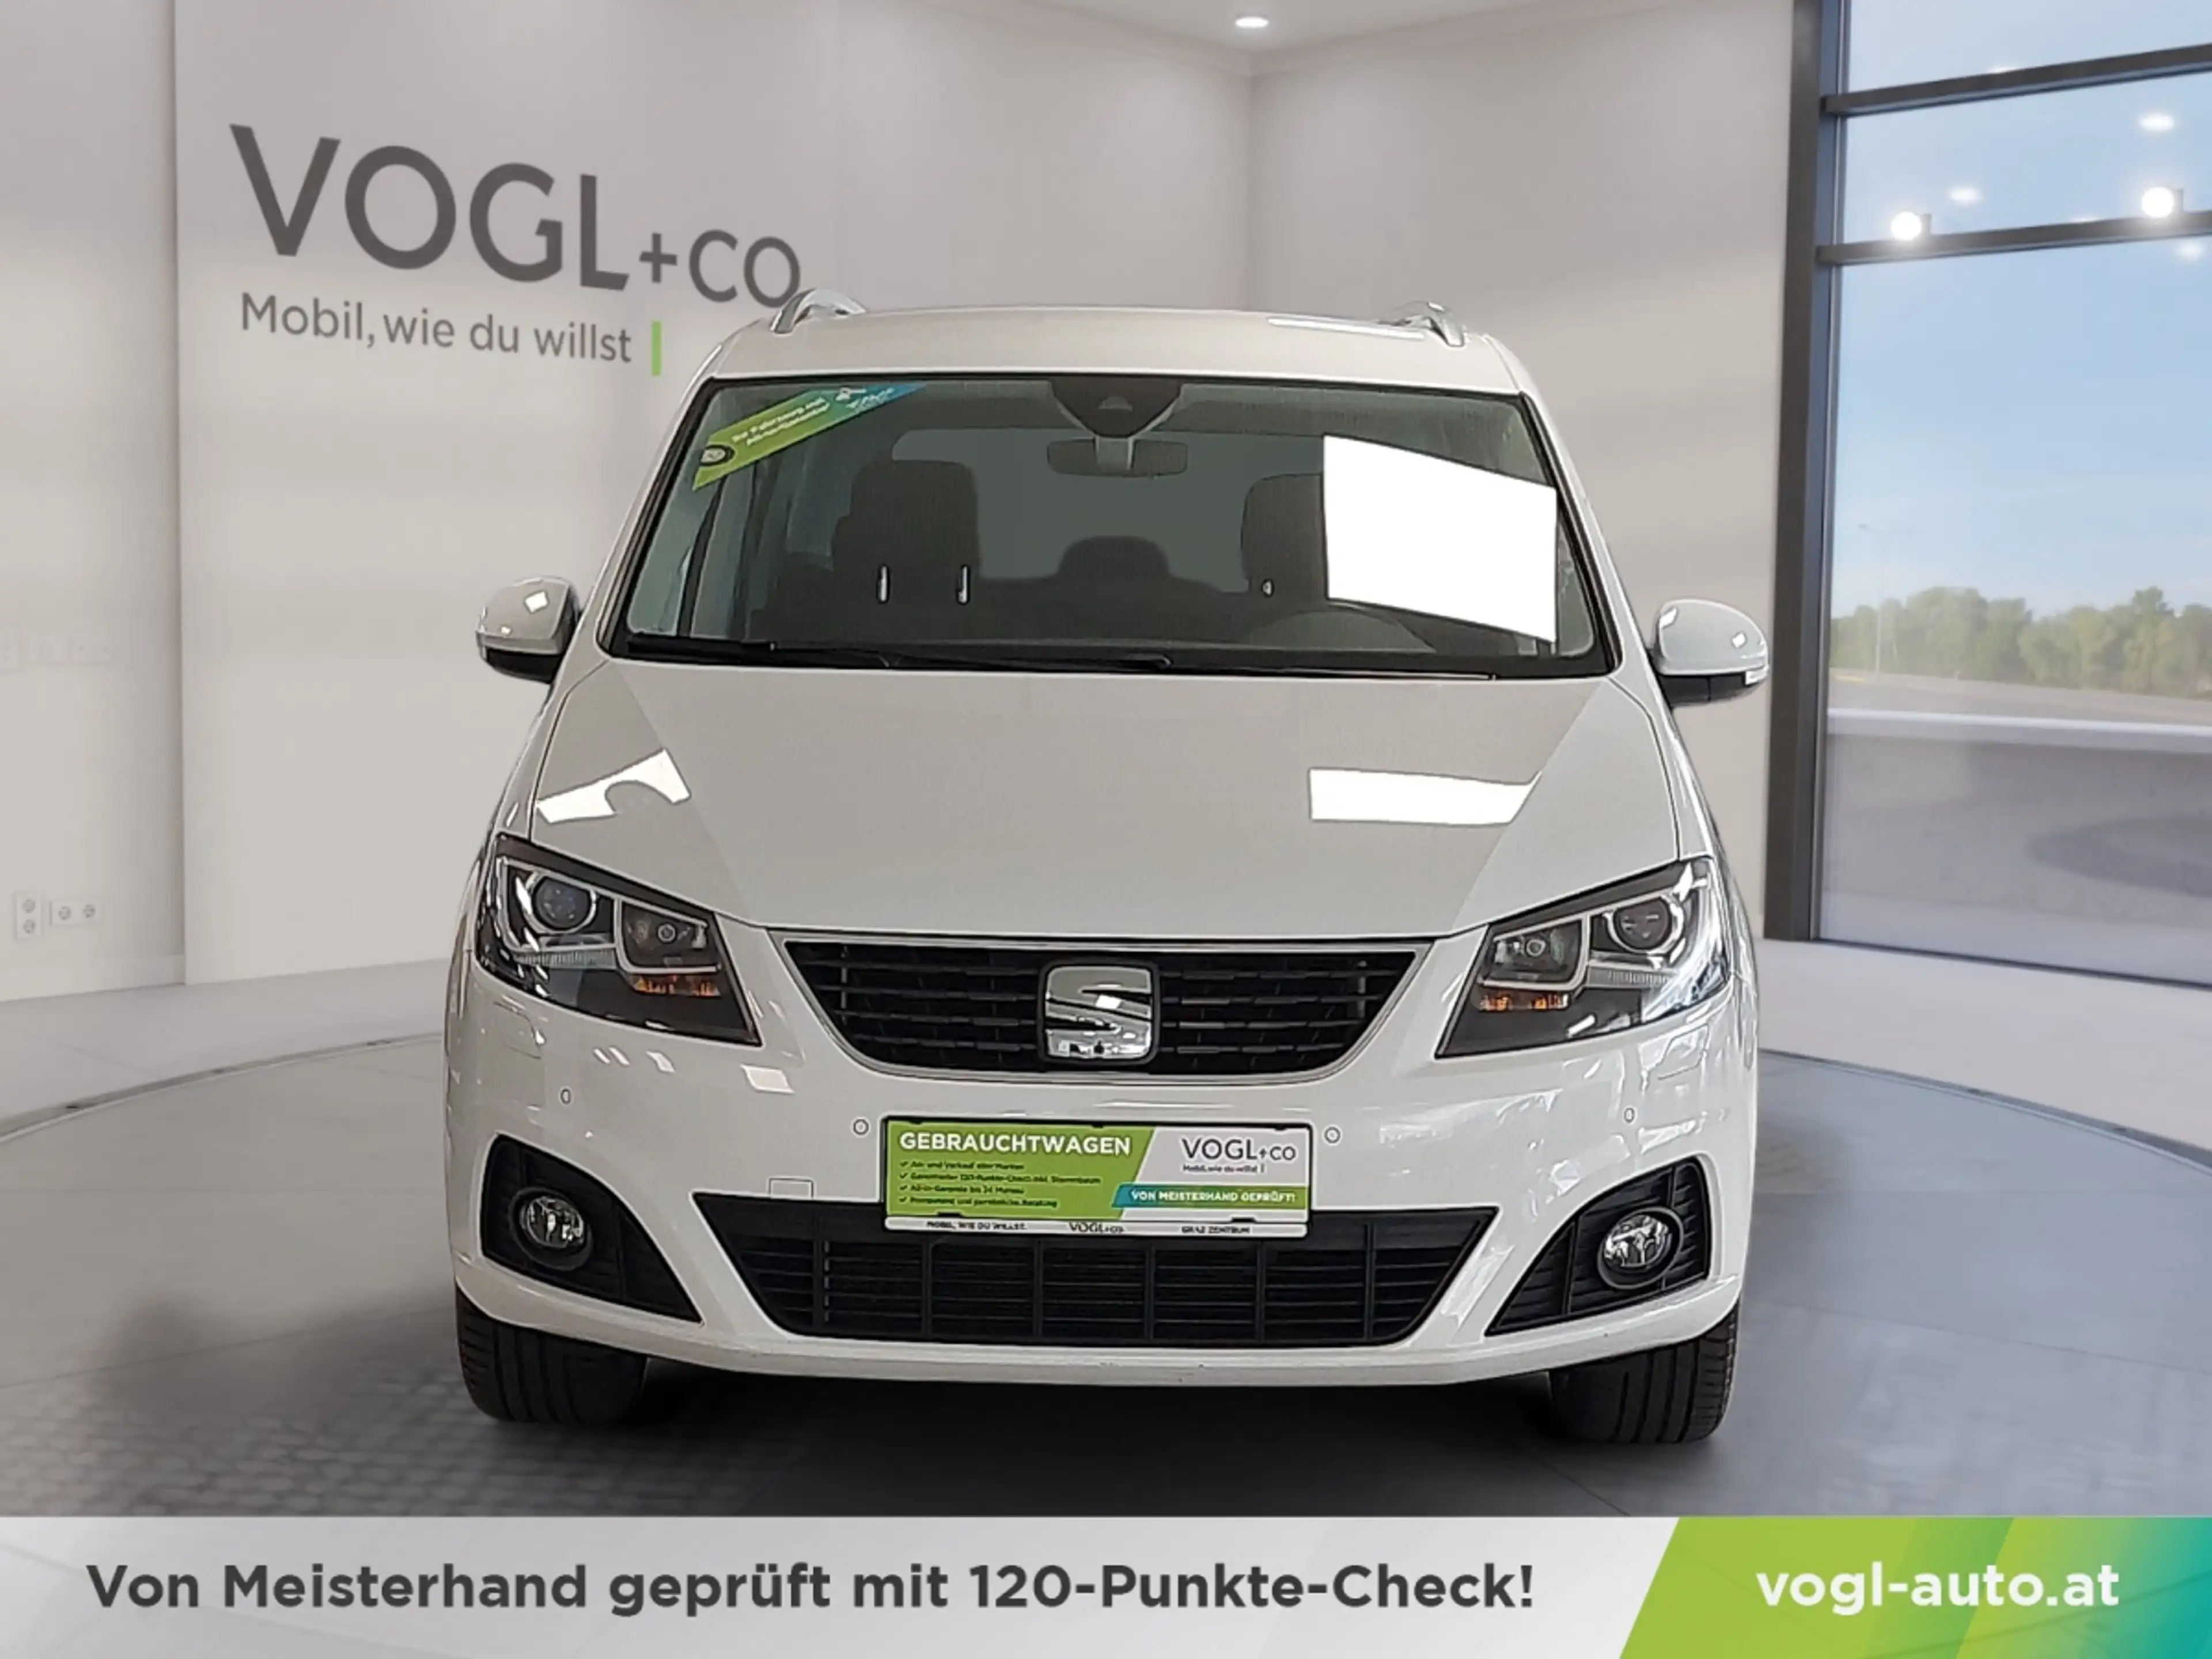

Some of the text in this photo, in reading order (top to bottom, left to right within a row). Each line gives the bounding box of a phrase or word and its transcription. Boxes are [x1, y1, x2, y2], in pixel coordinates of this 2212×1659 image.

[242, 291, 632, 363] Mobil, wie du willst
[899, 1131, 1131, 1156] GEBRAUCHTWAGEN
[1181, 1138, 1297, 1161] VOGL+CO
[1131, 1190, 1156, 1202] VON
[1158, 1191, 1238, 1202] MEISTERHAND
